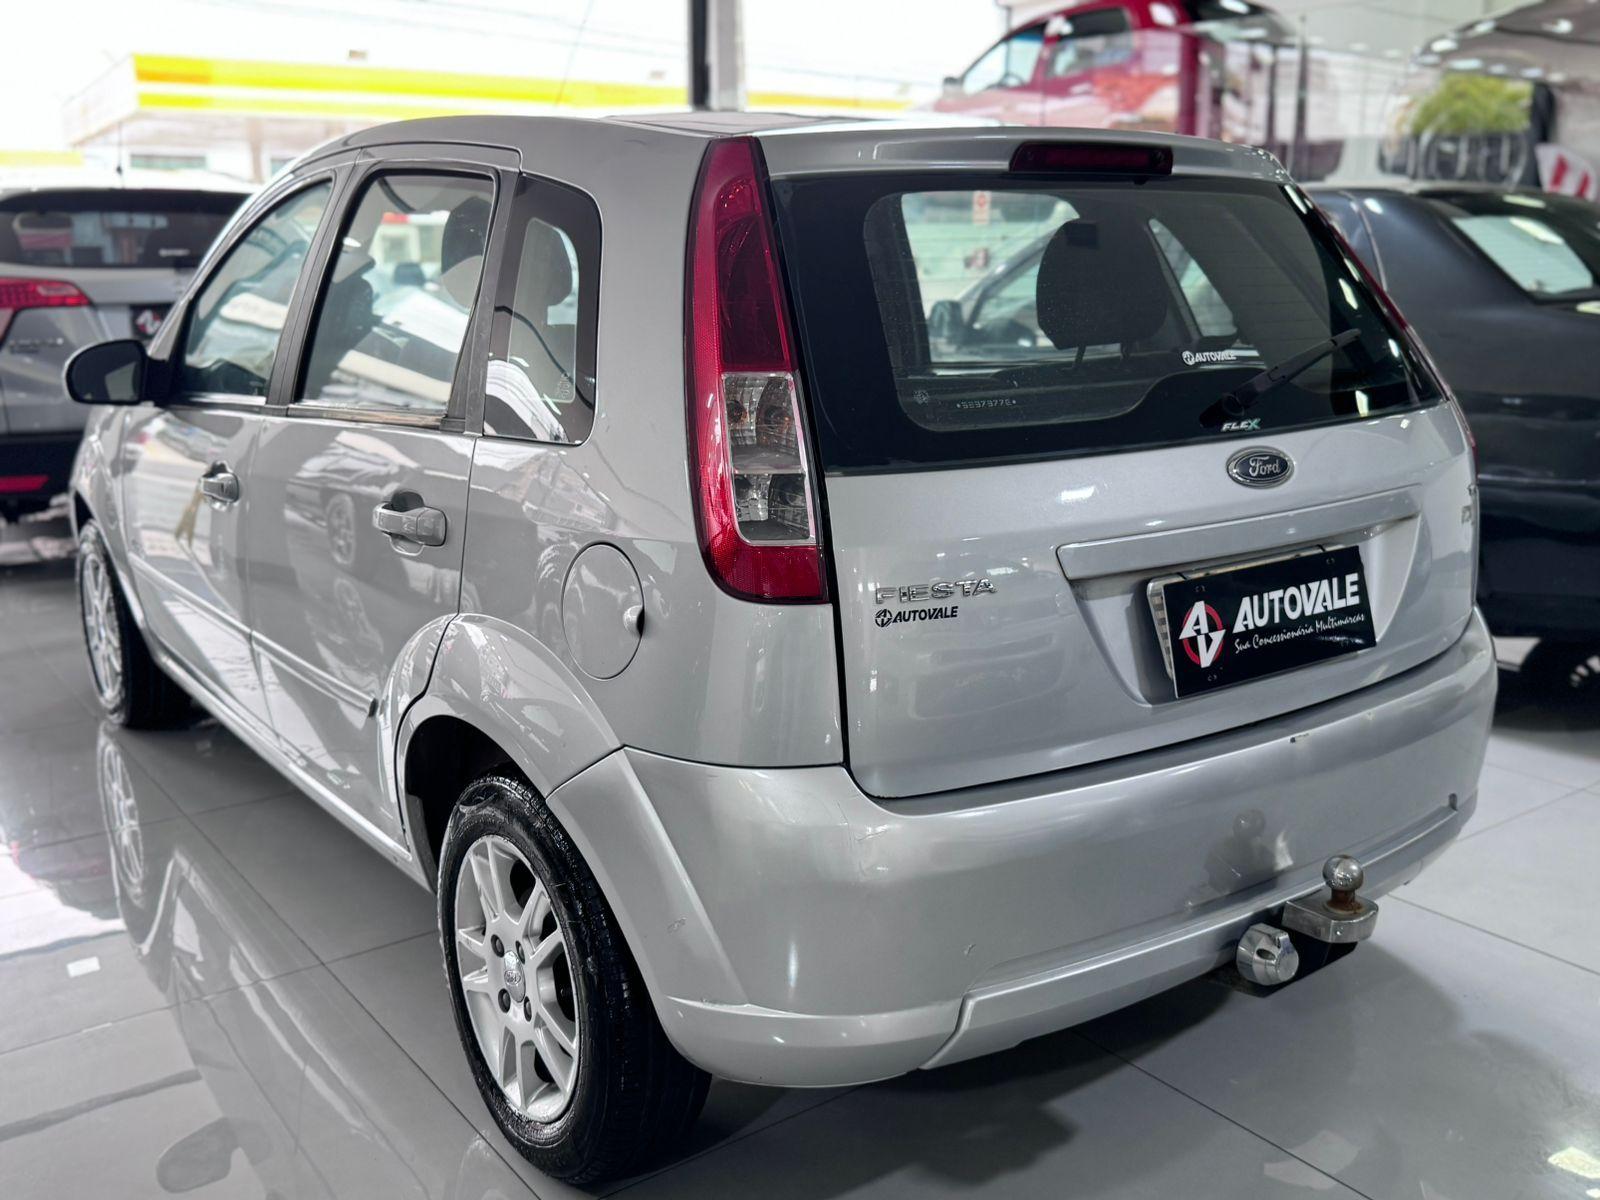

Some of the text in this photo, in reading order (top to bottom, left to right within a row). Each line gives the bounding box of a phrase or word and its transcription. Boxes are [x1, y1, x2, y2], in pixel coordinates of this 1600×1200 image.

[1221, 418, 1261, 432] FLEX
[1249, 456, 1281, 477] Ford
[875, 578, 997, 604] FIESTA
[1232, 572, 1360, 633] AUTOVALE
[892, 606, 959, 623] AUTOVALE
[1234, 638, 1251, 654] Sua
[1315, 612, 1365, 633] Multimarcas
